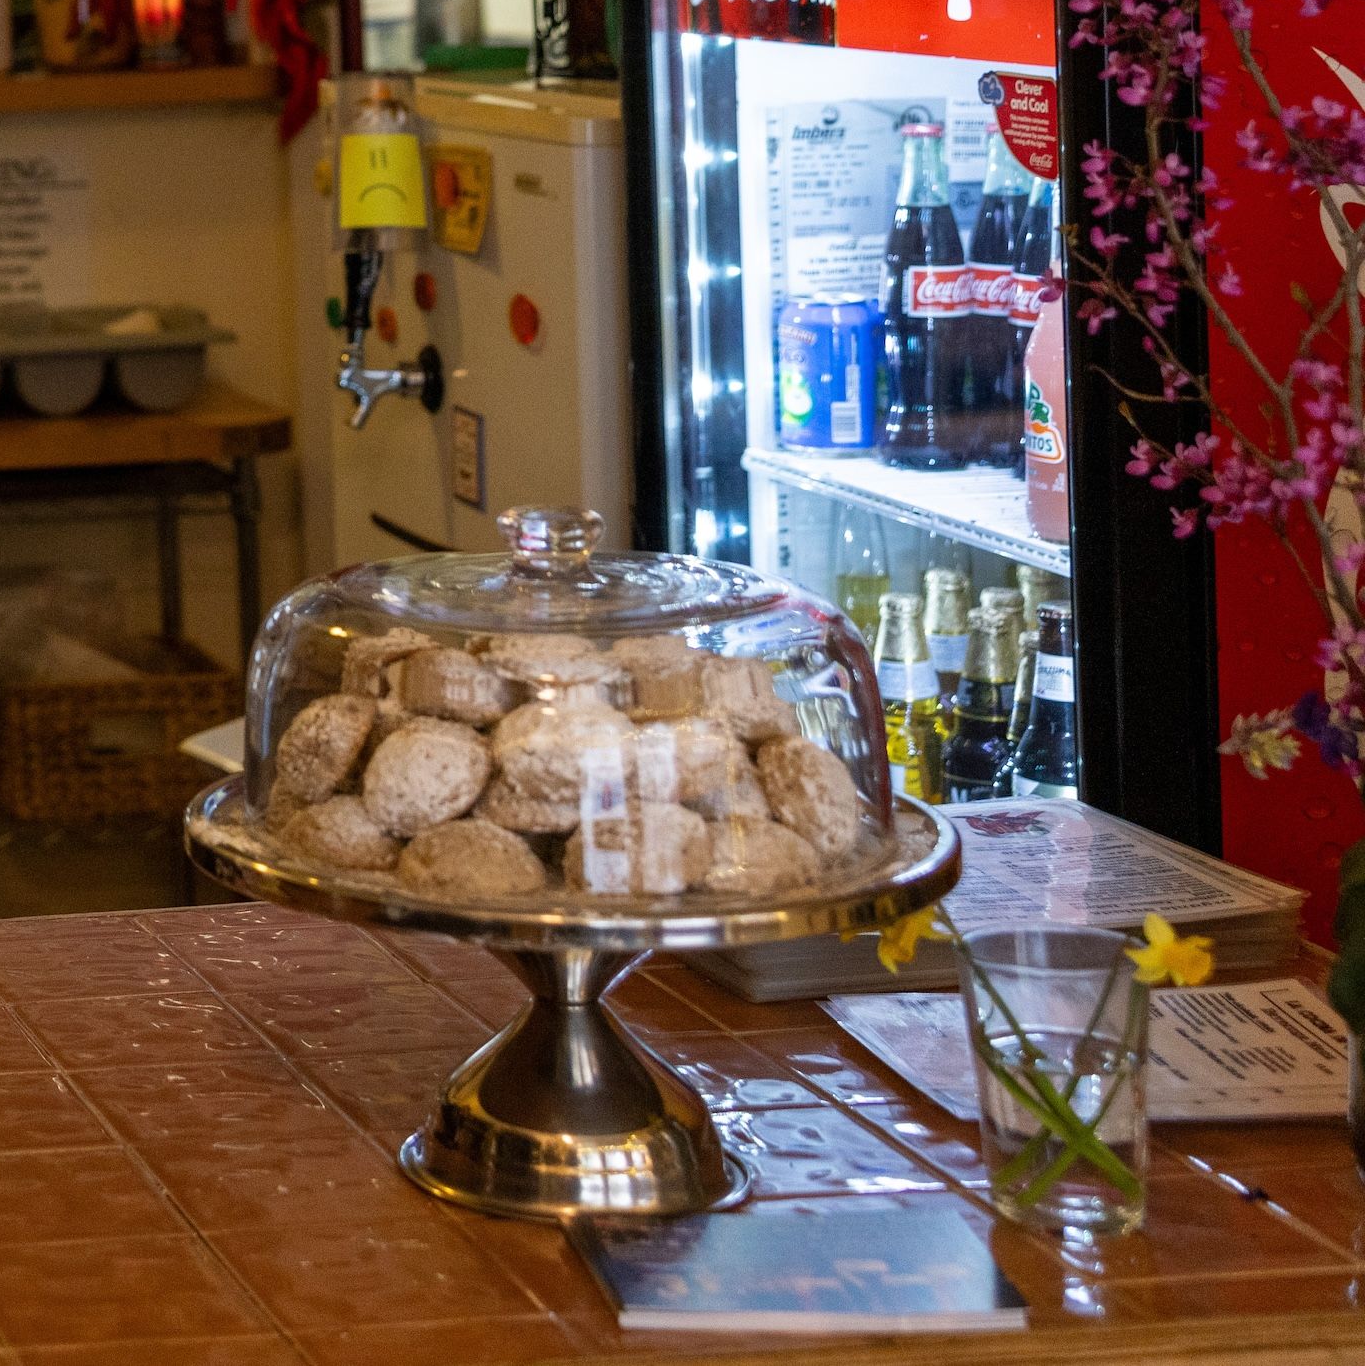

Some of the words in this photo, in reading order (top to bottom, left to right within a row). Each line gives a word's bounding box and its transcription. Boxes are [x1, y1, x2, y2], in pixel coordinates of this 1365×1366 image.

[1014, 79, 1044, 96] Clever
[1010, 96, 1028, 111] and
[1029, 97, 1049, 114] Cool
